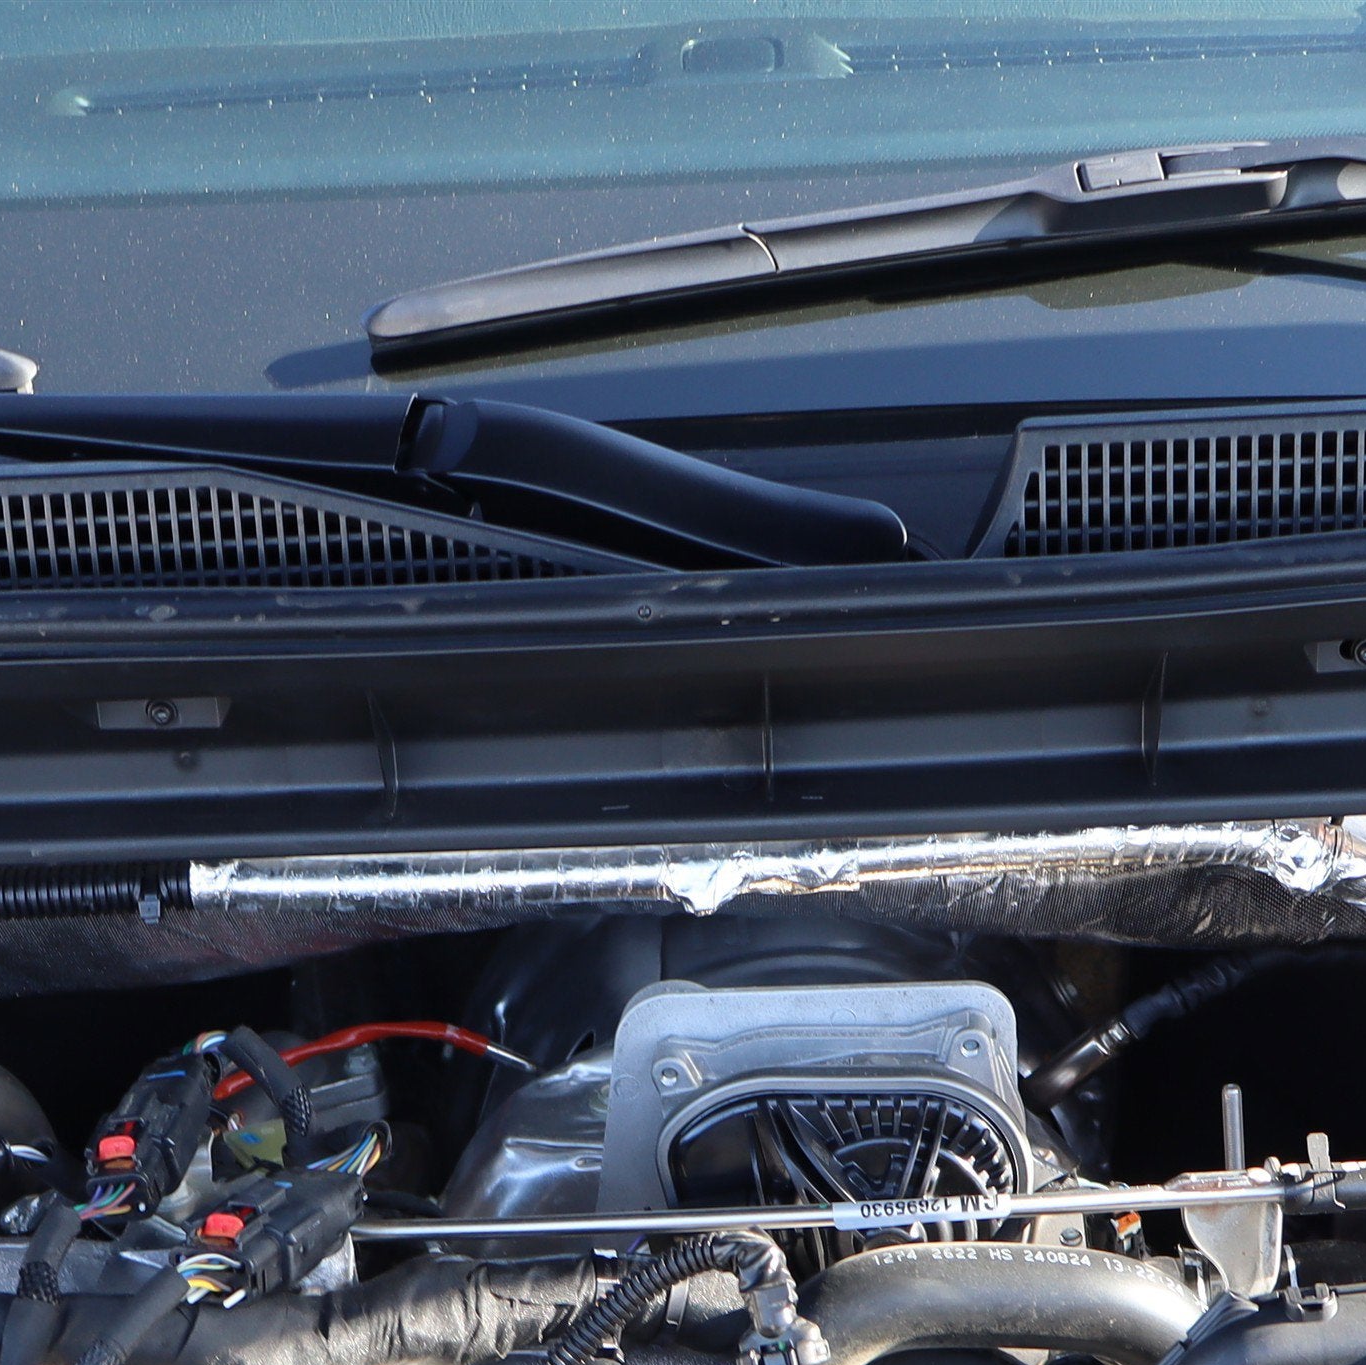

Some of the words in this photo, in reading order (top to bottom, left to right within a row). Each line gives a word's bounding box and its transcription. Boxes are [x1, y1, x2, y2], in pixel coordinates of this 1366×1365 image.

[861, 1198, 952, 1219] 12695930
[931, 1248, 978, 1260] 2622
[989, 1248, 1014, 1261] HS
[1023, 1249, 1091, 1267] 240824
